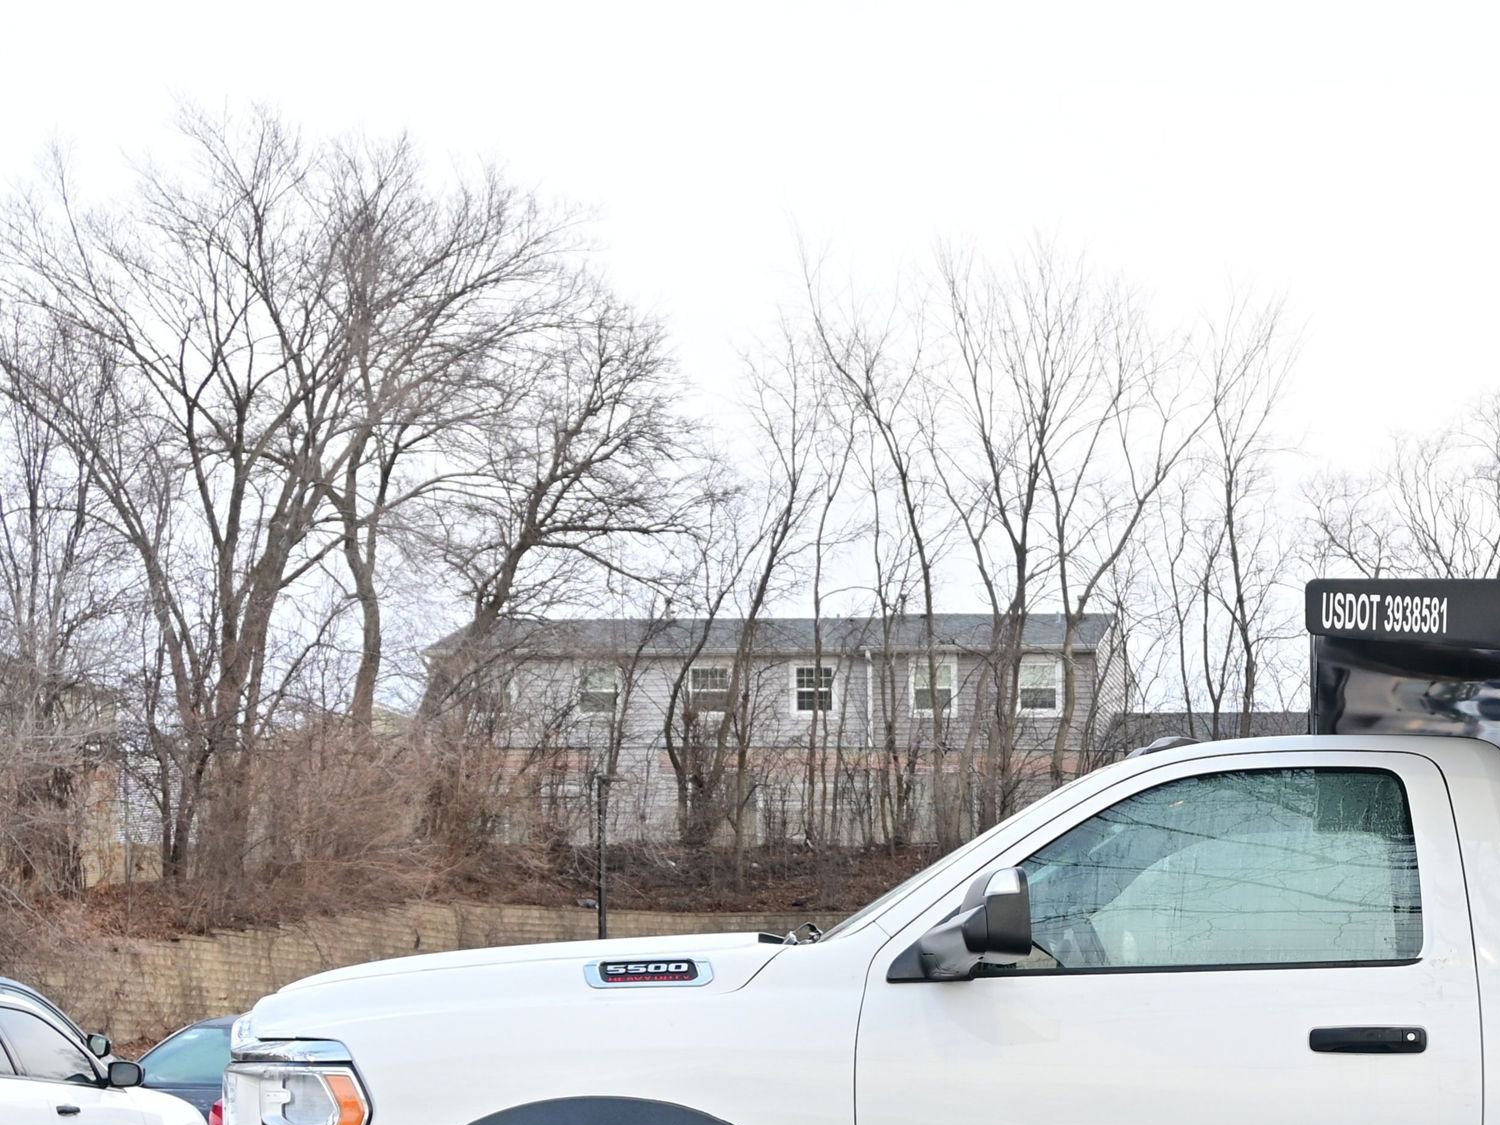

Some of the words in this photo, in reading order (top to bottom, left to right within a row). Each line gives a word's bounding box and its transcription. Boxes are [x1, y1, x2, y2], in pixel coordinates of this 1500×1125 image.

[1322, 592, 1381, 631] USDOT
[1384, 594, 1448, 634] 3938581
[606, 963, 689, 974] 5500
